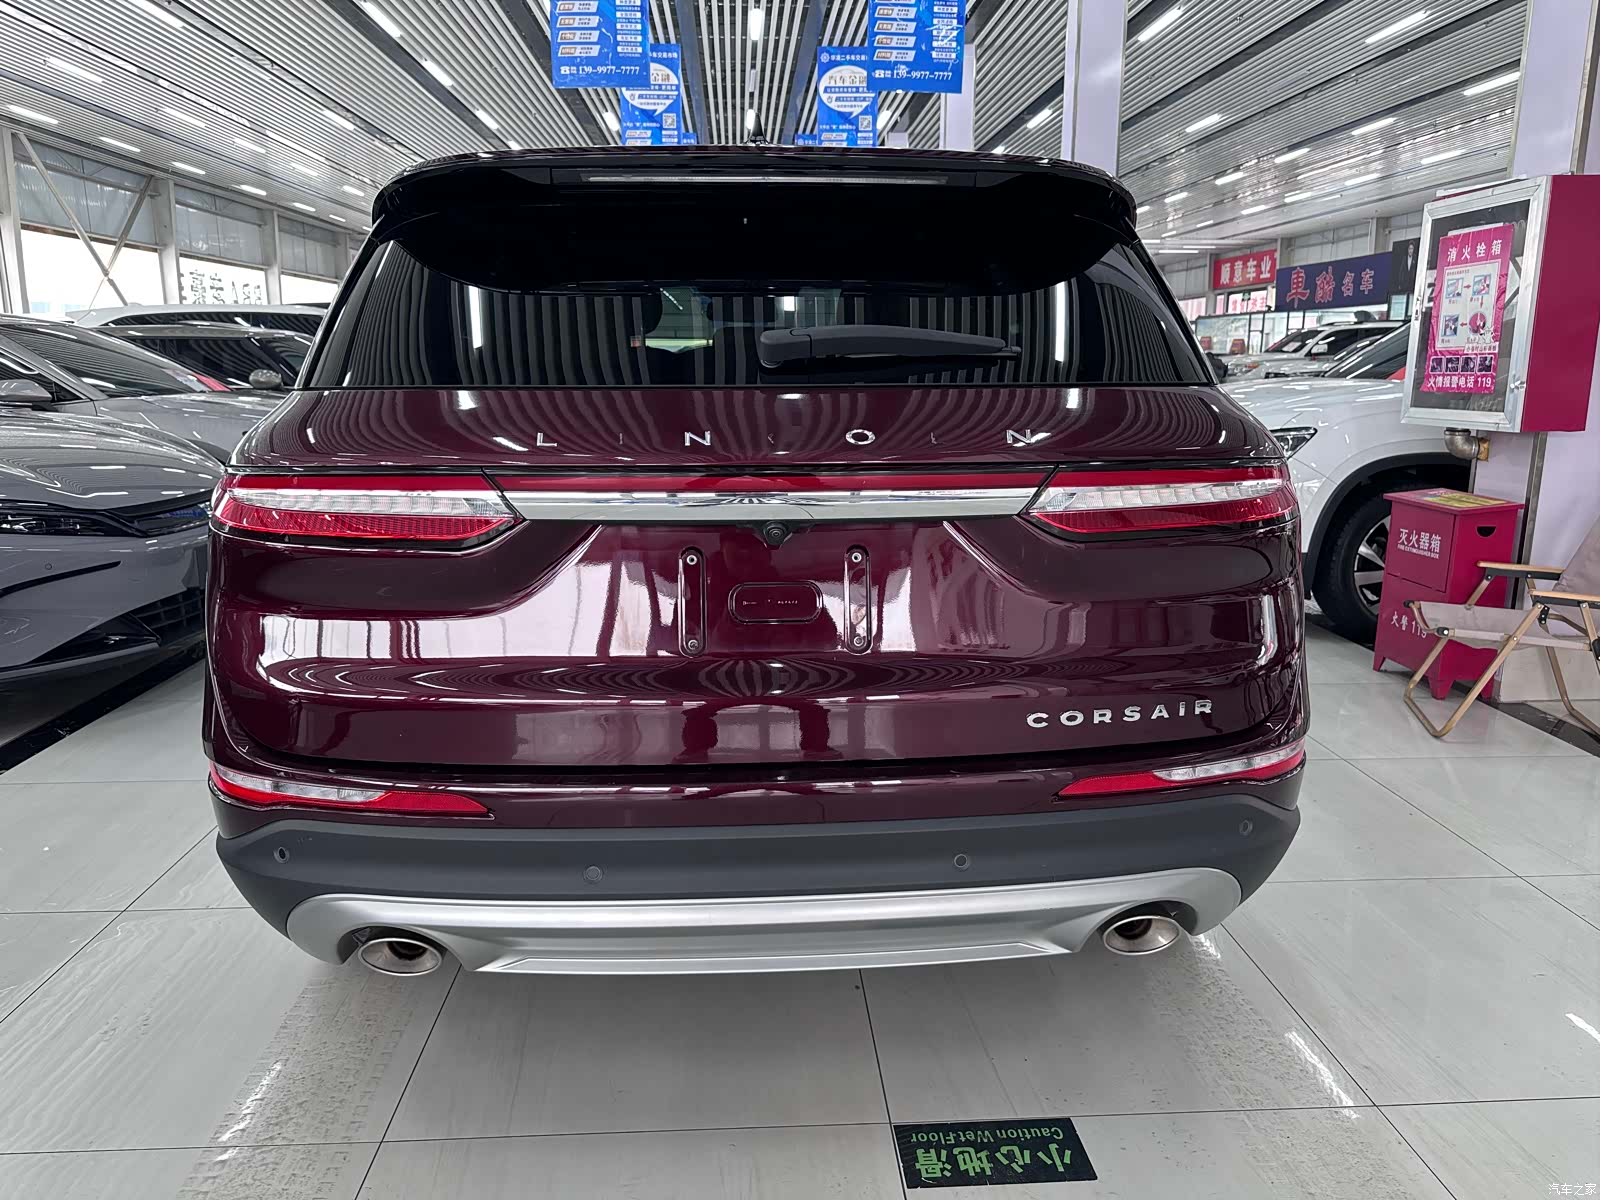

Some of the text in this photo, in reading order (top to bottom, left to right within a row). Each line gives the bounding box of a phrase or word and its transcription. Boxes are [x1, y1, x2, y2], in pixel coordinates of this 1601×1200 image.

[579, 65, 640, 75] 139-9977-7777
[893, 68, 953, 81] 139-9977-7777
[1447, 239, 1502, 262] 消火栓箱
[1219, 255, 1271, 285] 顺意车业
[1427, 375, 1492, 389] 火情报警电话 119
[1398, 528, 1441, 553] 灭火器箱
[1390, 611, 1409, 631] 火警
[1026, 700, 1213, 728] CORSAIR
[910, 1127, 1064, 1145] Caution Wet Floor
[914, 1143, 1073, 1179] 小心地滑
